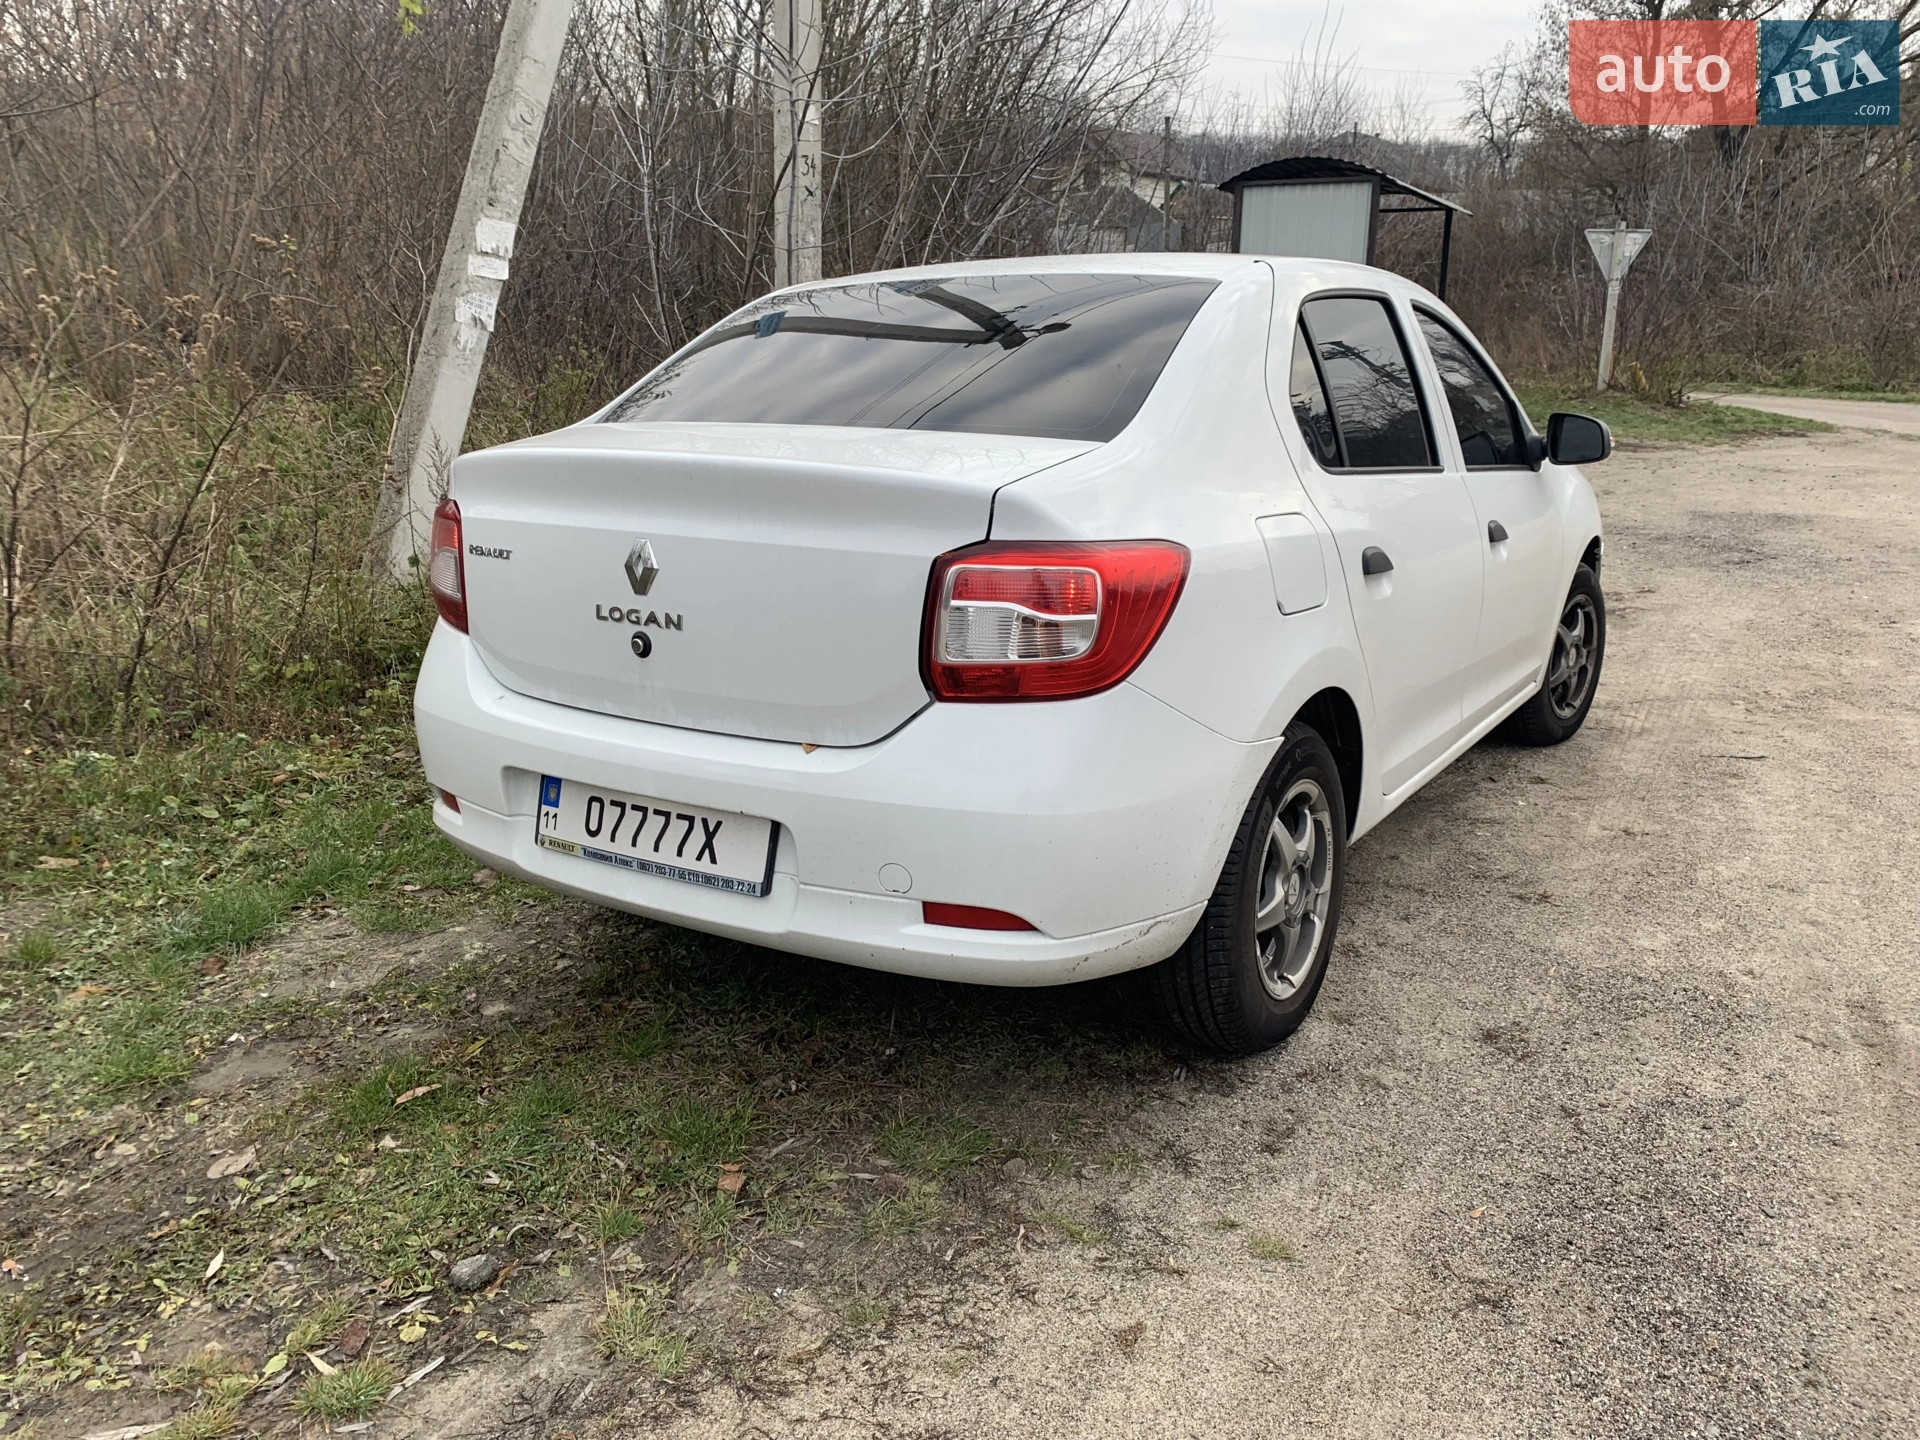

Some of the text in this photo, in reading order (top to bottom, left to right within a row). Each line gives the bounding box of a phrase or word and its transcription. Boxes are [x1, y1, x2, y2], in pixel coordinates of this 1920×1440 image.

[801, 154, 817, 178] 34
[469, 544, 512, 560] RENAULT
[595, 603, 684, 631] LOGAN
[543, 810, 558, 831] 11
[548, 839, 575, 853] RENAULT
[654, 864, 687, 881] 203-77-55
[720, 878, 757, 894] 203-72-24
